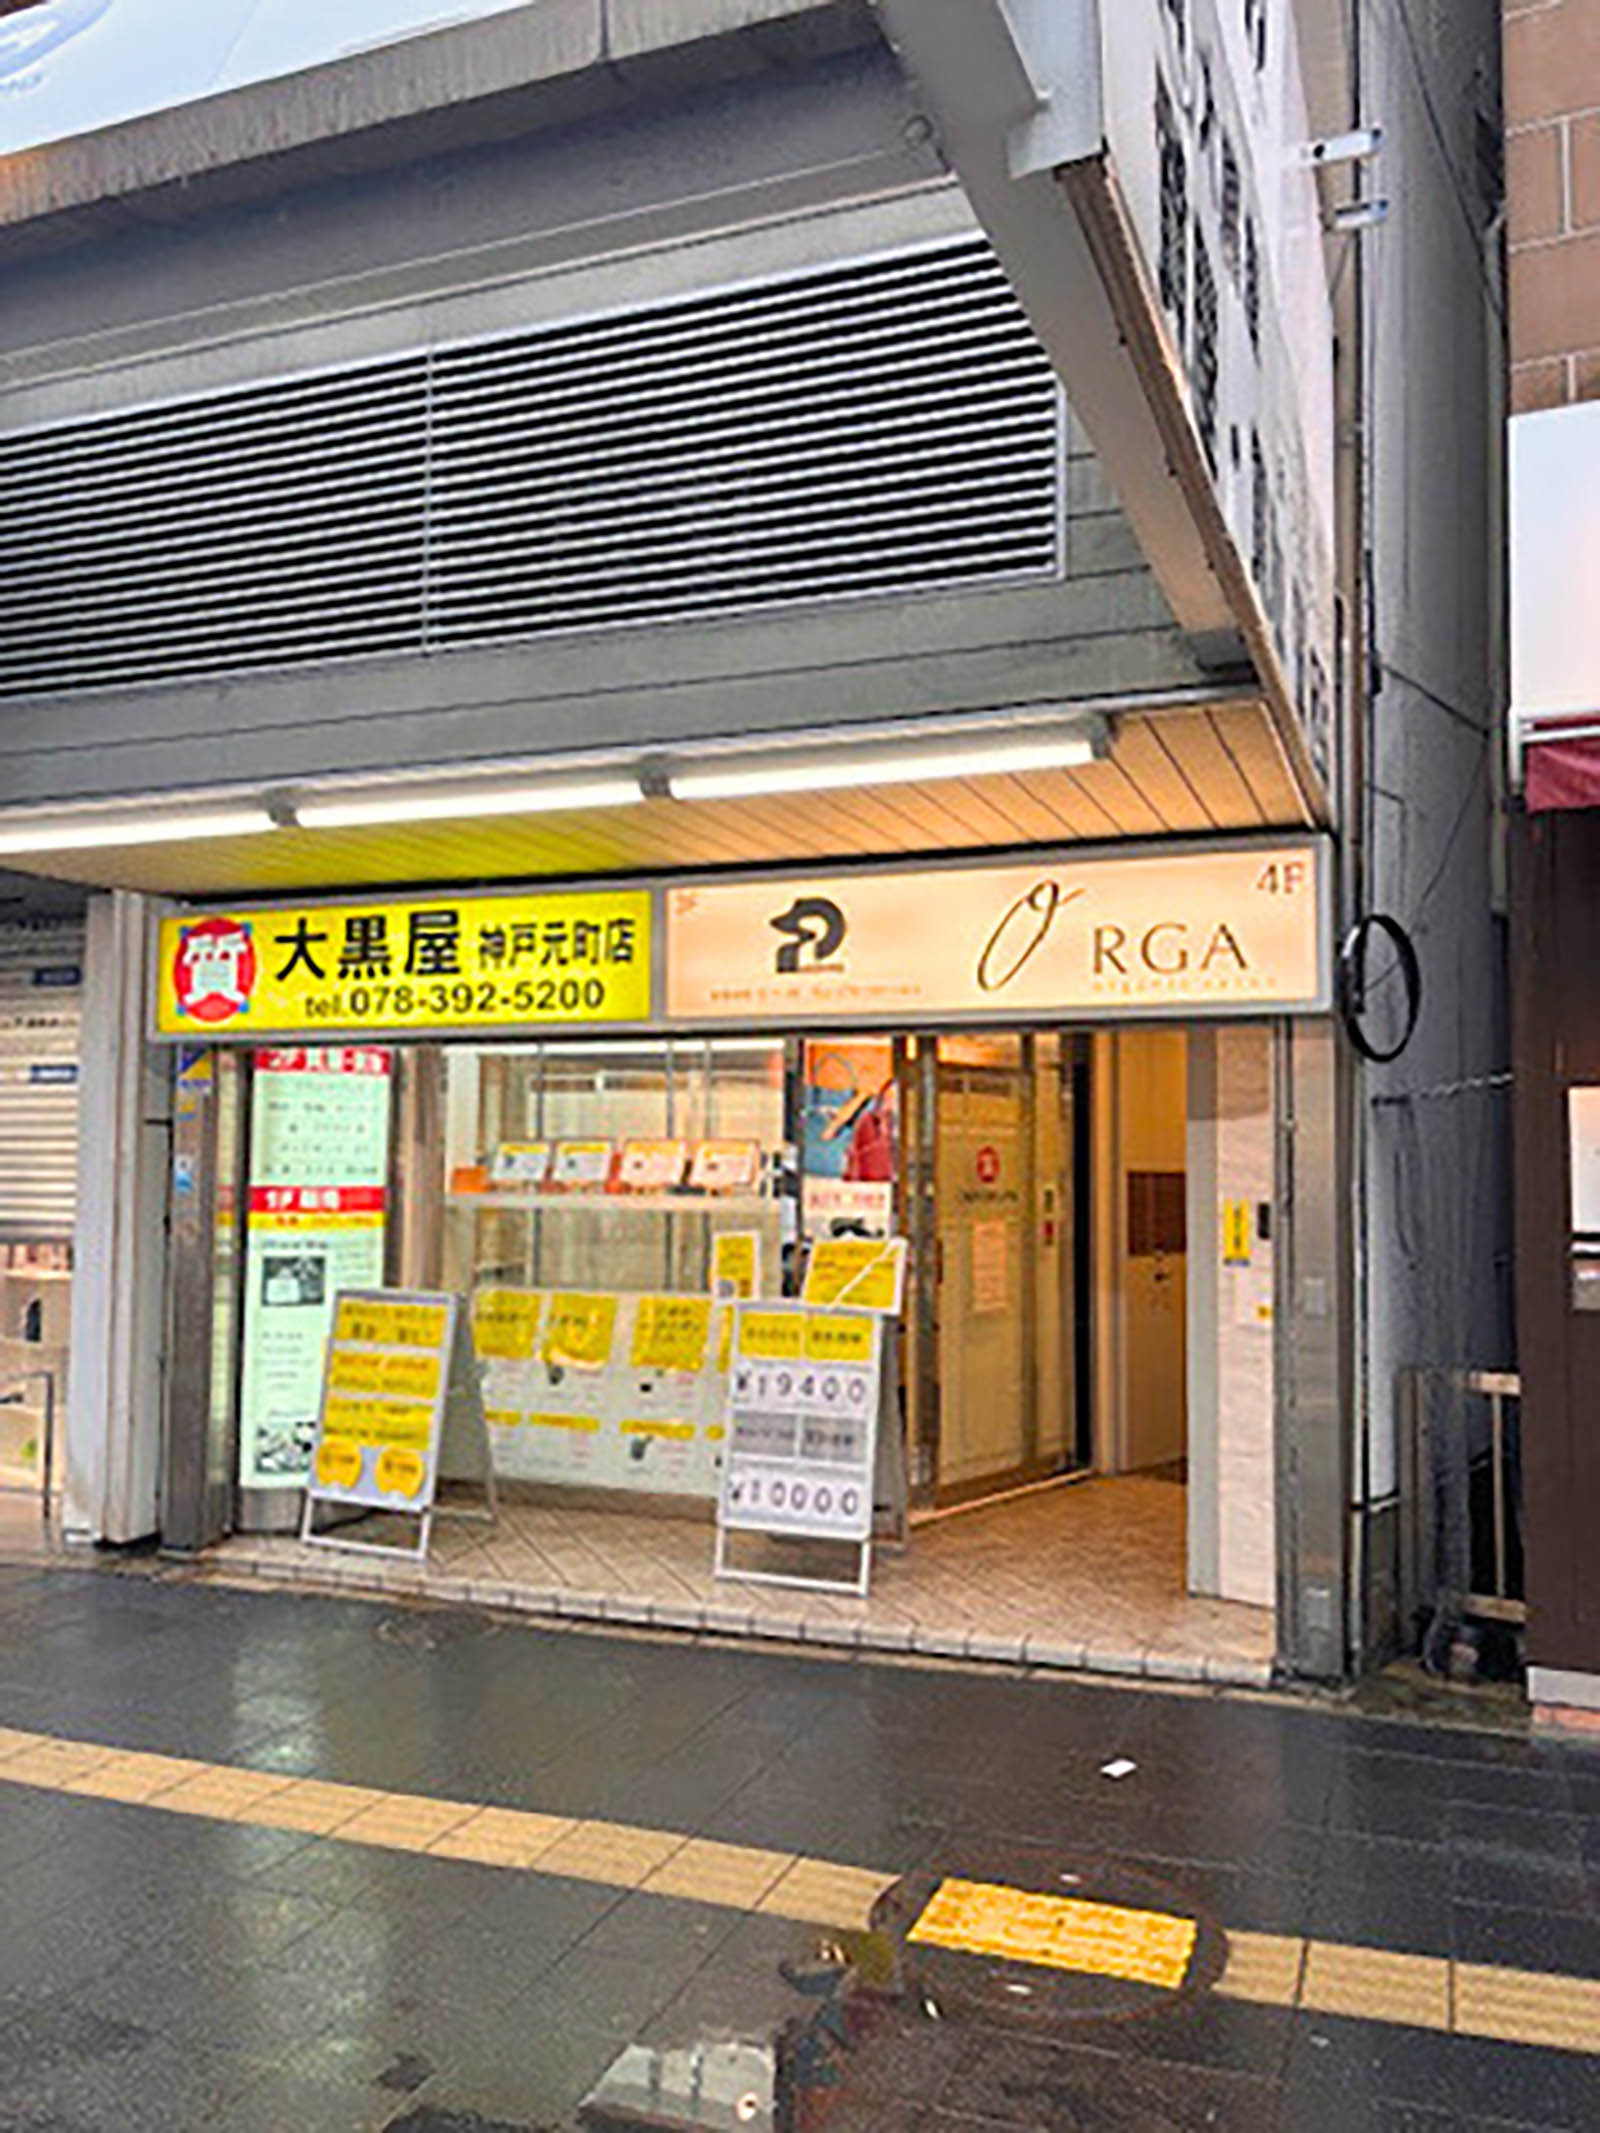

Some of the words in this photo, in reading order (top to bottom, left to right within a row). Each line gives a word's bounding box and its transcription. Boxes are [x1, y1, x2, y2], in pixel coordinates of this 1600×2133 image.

[1257, 862, 1305, 894] 4F
[274, 910, 464, 982] 大黒屋
[478, 917, 637, 970] 神戸元町店
